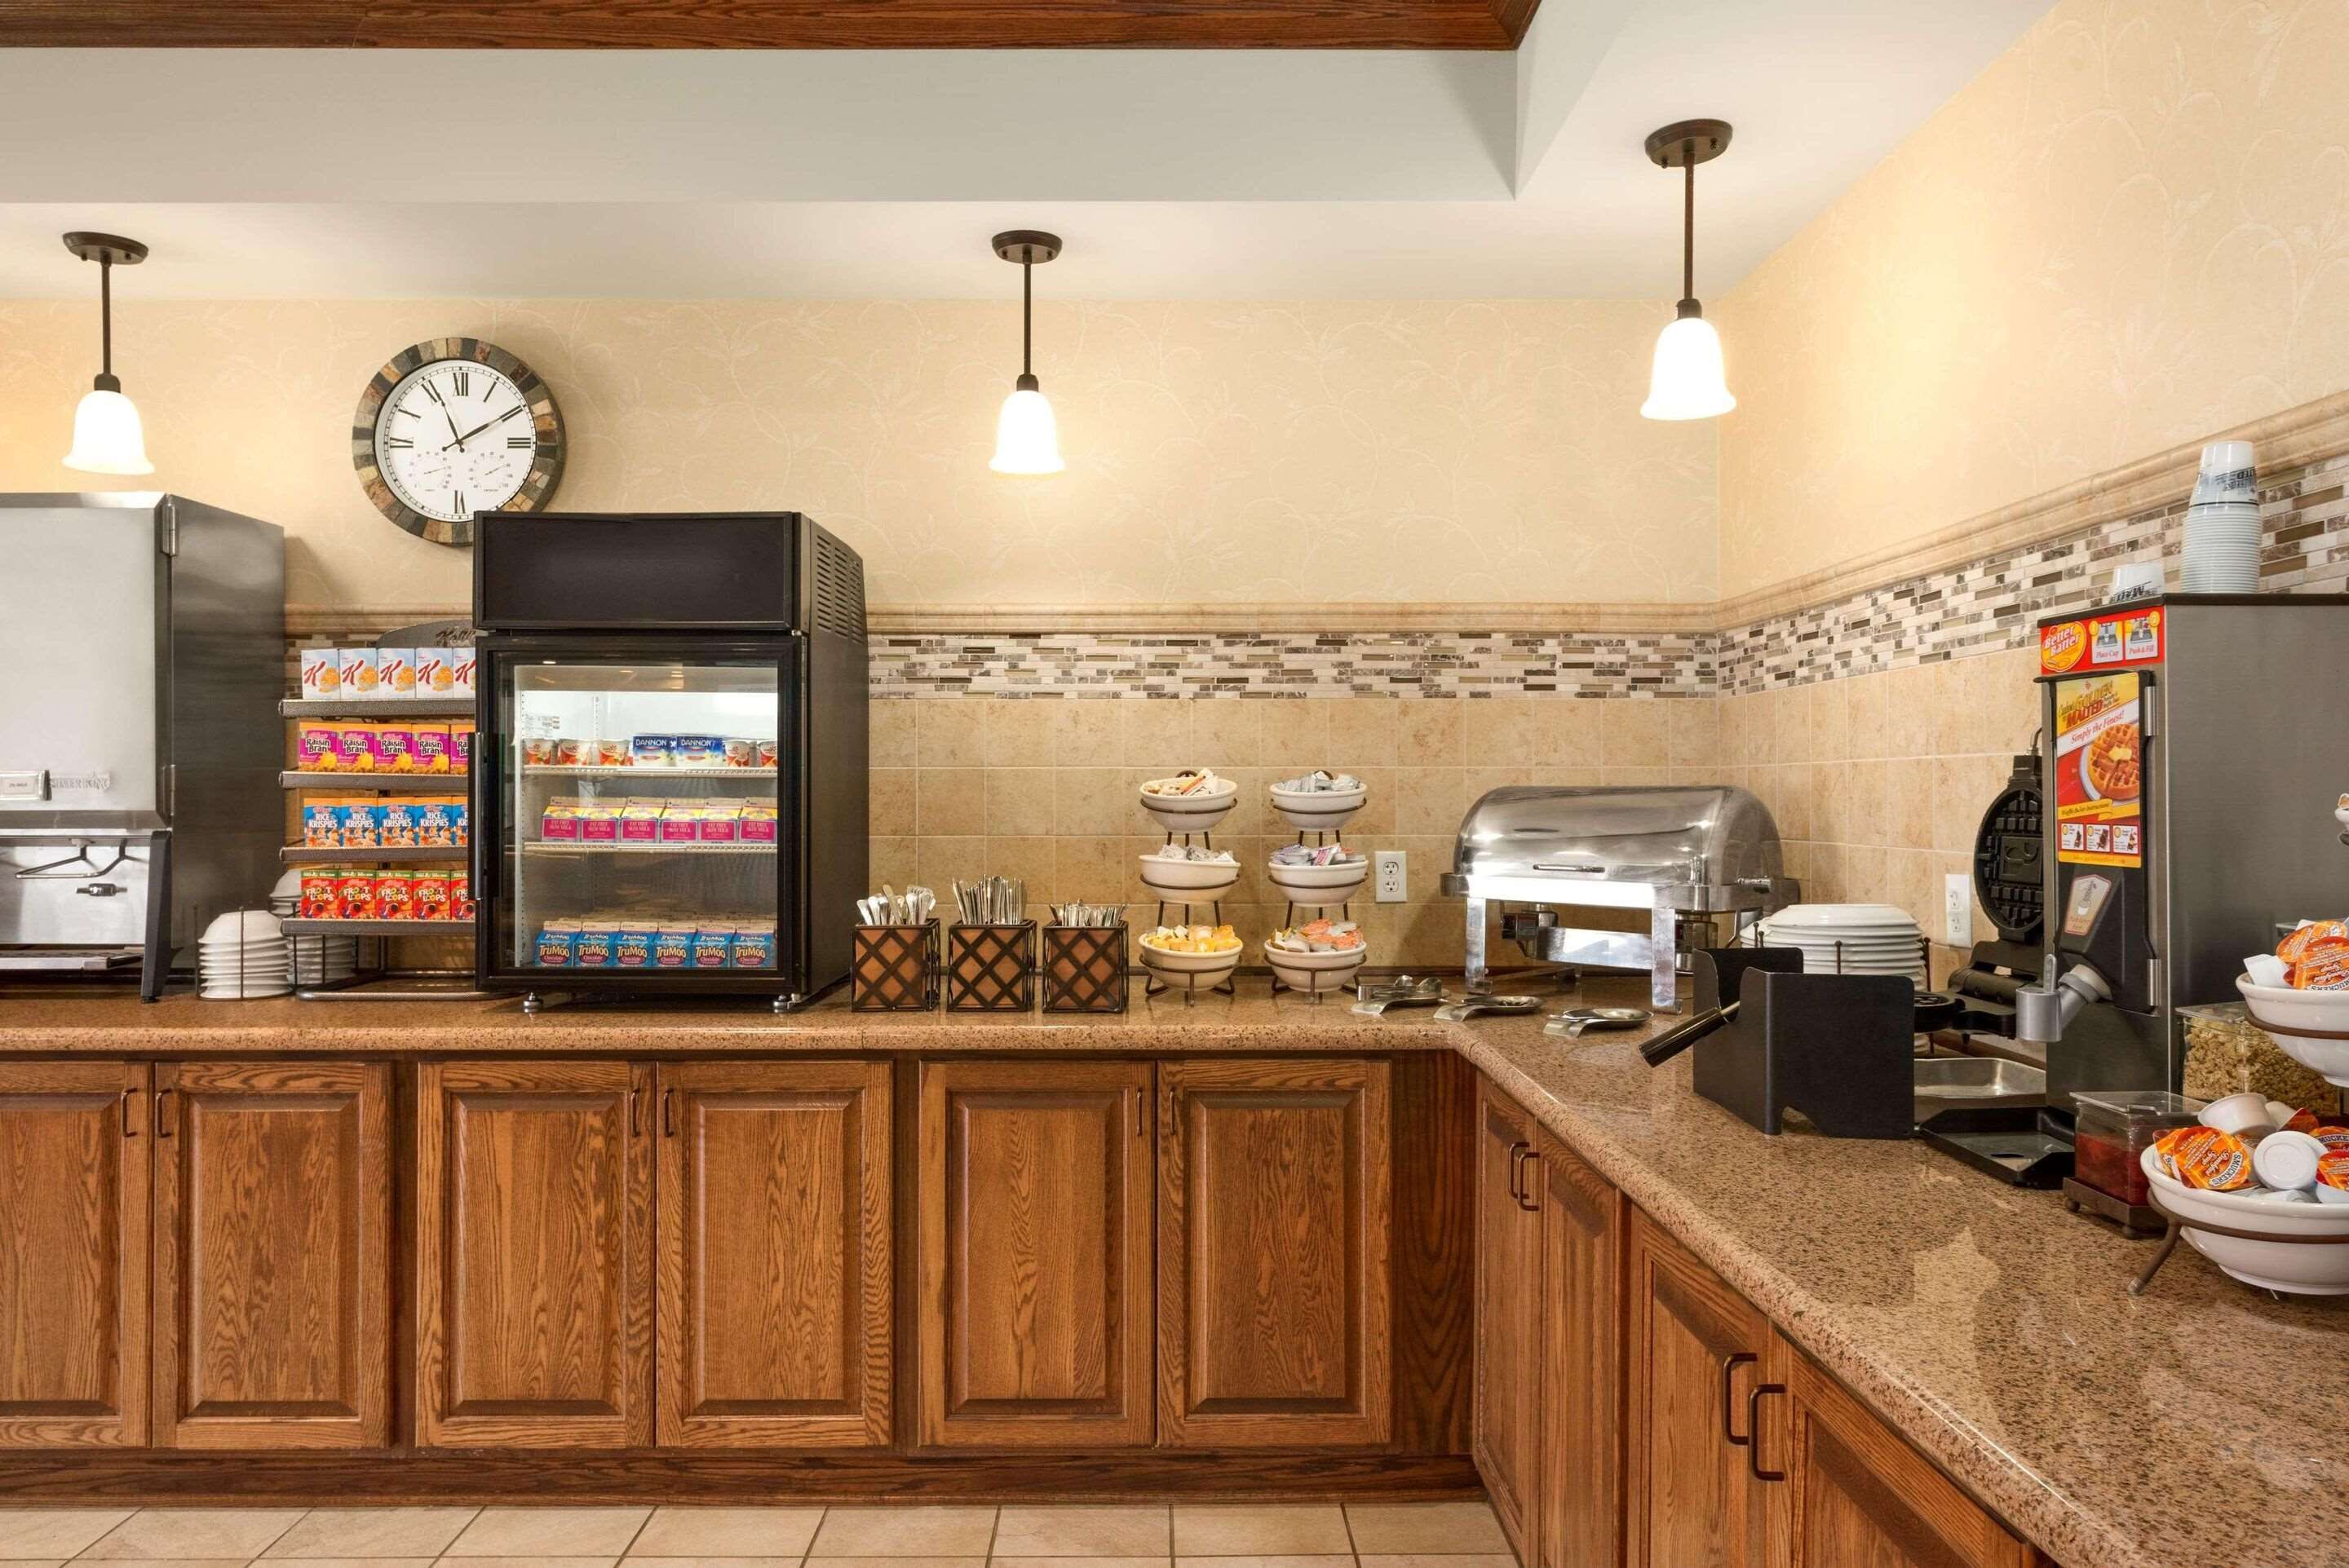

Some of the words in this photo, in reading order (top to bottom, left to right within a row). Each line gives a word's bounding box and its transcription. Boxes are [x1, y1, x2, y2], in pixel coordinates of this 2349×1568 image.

[453, 372, 469, 396] XII
[2043, 626, 2075, 649] Better
[2050, 633, 2081, 656] Batter
[303, 660, 326, 686] K
[342, 660, 364, 685] K
[380, 660, 403, 684] K
[418, 659, 440, 684] K
[455, 660, 476, 684] K
[2065, 699, 2103, 728] MALTED
[2071, 727, 2091, 744] Simply
[2092, 721, 2103, 732] the
[306, 738, 330, 747] Raisin
[343, 739, 367, 748] Raisin
[381, 740, 405, 749] Raisin
[418, 740, 443, 749] Raisin
[308, 745, 329, 753] Bran
[316, 813, 330, 821] RICE
[352, 813, 366, 821] RICE
[383, 818, 412, 827] KRISPIES
[420, 818, 449, 827] KRISPIES
[308, 819, 338, 828] KRISPIES
[346, 819, 374, 828] KRISPIES
[310, 893, 334, 901] LOOPS
[348, 893, 372, 901] LOOPS
[385, 894, 409, 902] LOOPS
[422, 894, 446, 902] LOOPS
[539, 944, 570, 956] TruMoo
[578, 944, 609, 956] TruMoo
[617, 945, 648, 957] TruMoo
[656, 945, 687, 958] TruMoo
[695, 946, 726, 958] TruMoo
[735, 946, 766, 958] TruMoo
